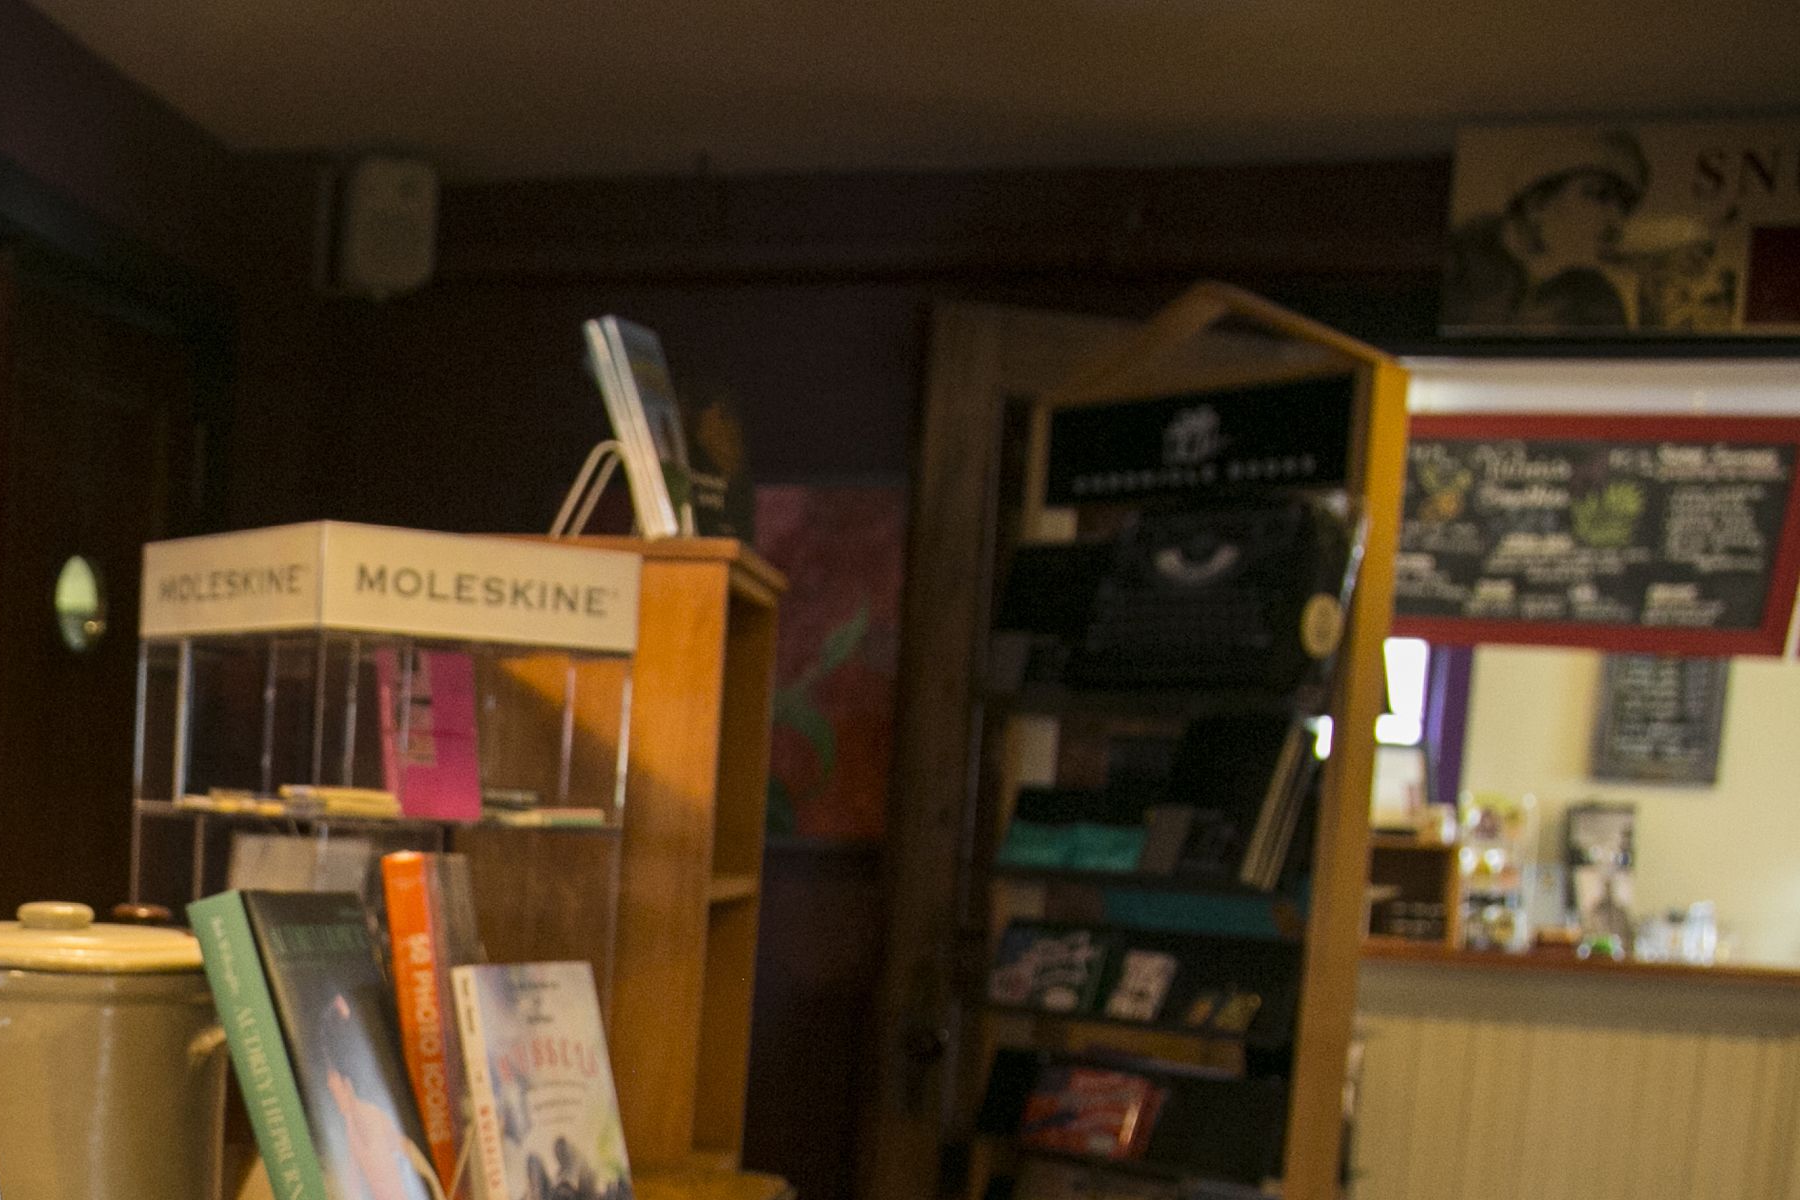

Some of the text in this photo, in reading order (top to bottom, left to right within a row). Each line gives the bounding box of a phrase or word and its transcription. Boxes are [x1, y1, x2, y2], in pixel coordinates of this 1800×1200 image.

[1694, 147, 1800, 197] SN
[158, 563, 301, 601] MOLESKINE
[356, 563, 609, 617] MOLESKINE
